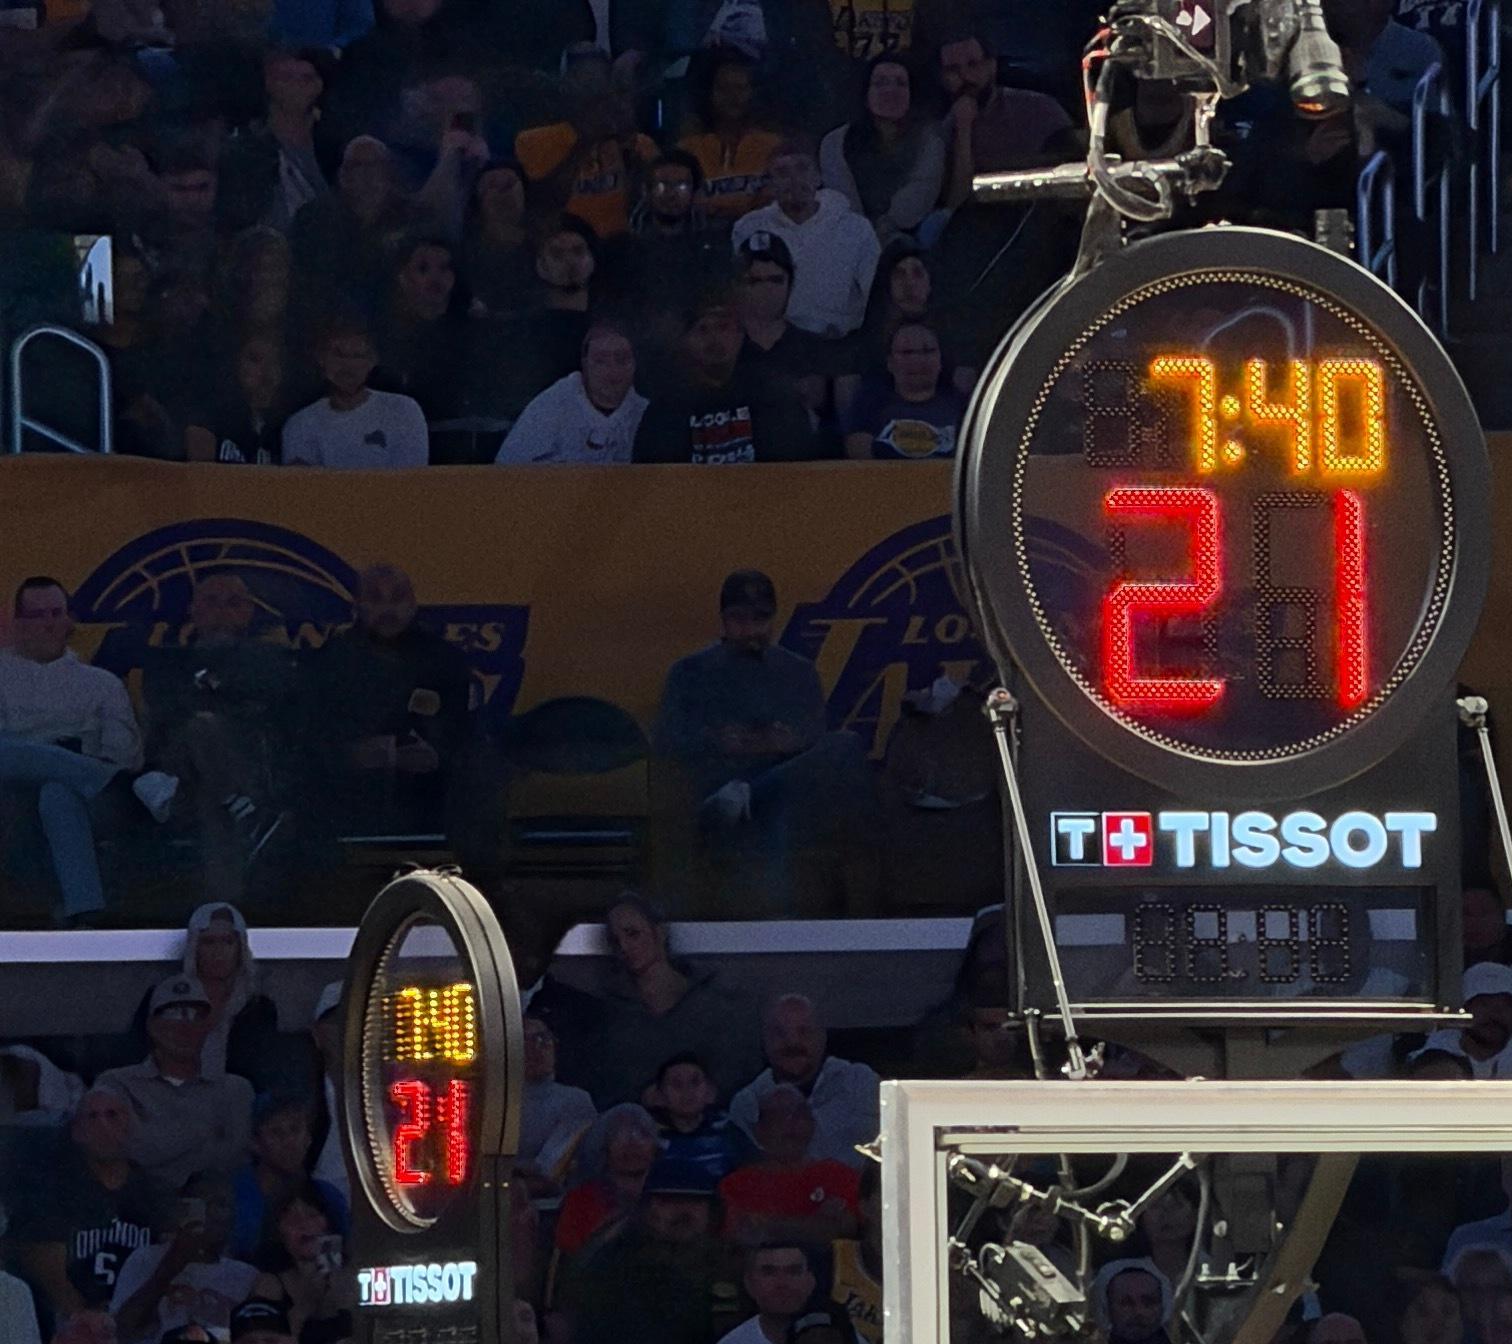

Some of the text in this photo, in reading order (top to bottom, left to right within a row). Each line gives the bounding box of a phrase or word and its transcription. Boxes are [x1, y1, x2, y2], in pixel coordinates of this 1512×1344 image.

[1152, 357, 1384, 473] 7:40
[1105, 486, 1370, 703] 21
[1159, 811, 1437, 869] TISSOT
[394, 1080, 469, 1185] 21
[94, 1251, 118, 1287] 5
[390, 1261, 477, 1305] TISSOT
